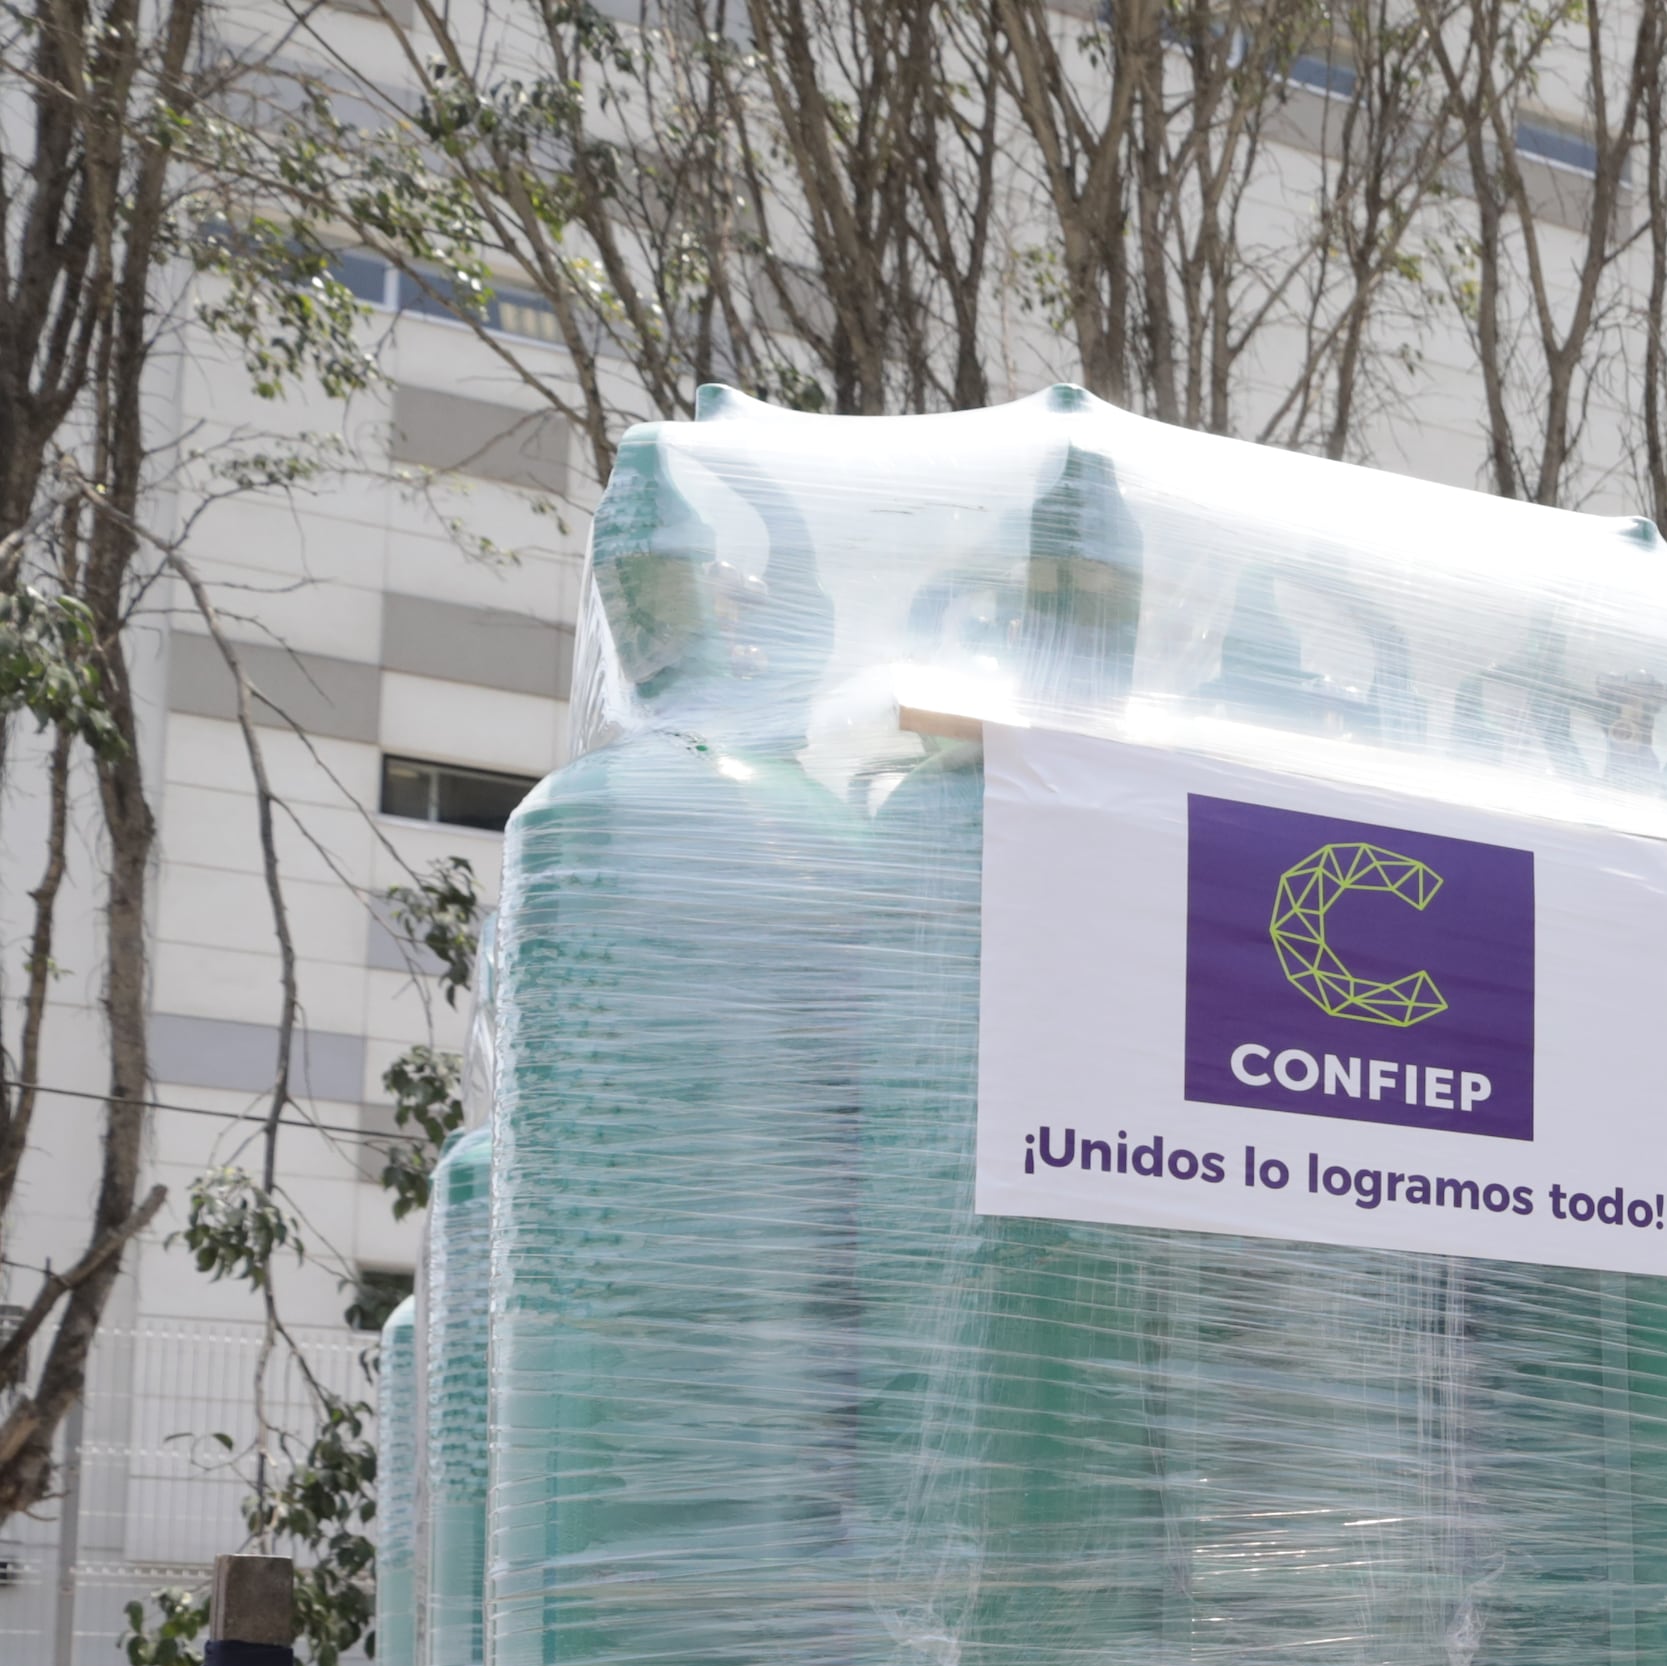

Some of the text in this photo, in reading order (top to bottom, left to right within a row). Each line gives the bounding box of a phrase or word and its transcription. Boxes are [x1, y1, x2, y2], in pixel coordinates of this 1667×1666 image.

[1229, 1043, 1492, 1112] CONFIEP
[1023, 1126, 1665, 1229] ¡Unidos lo logramos todo!
